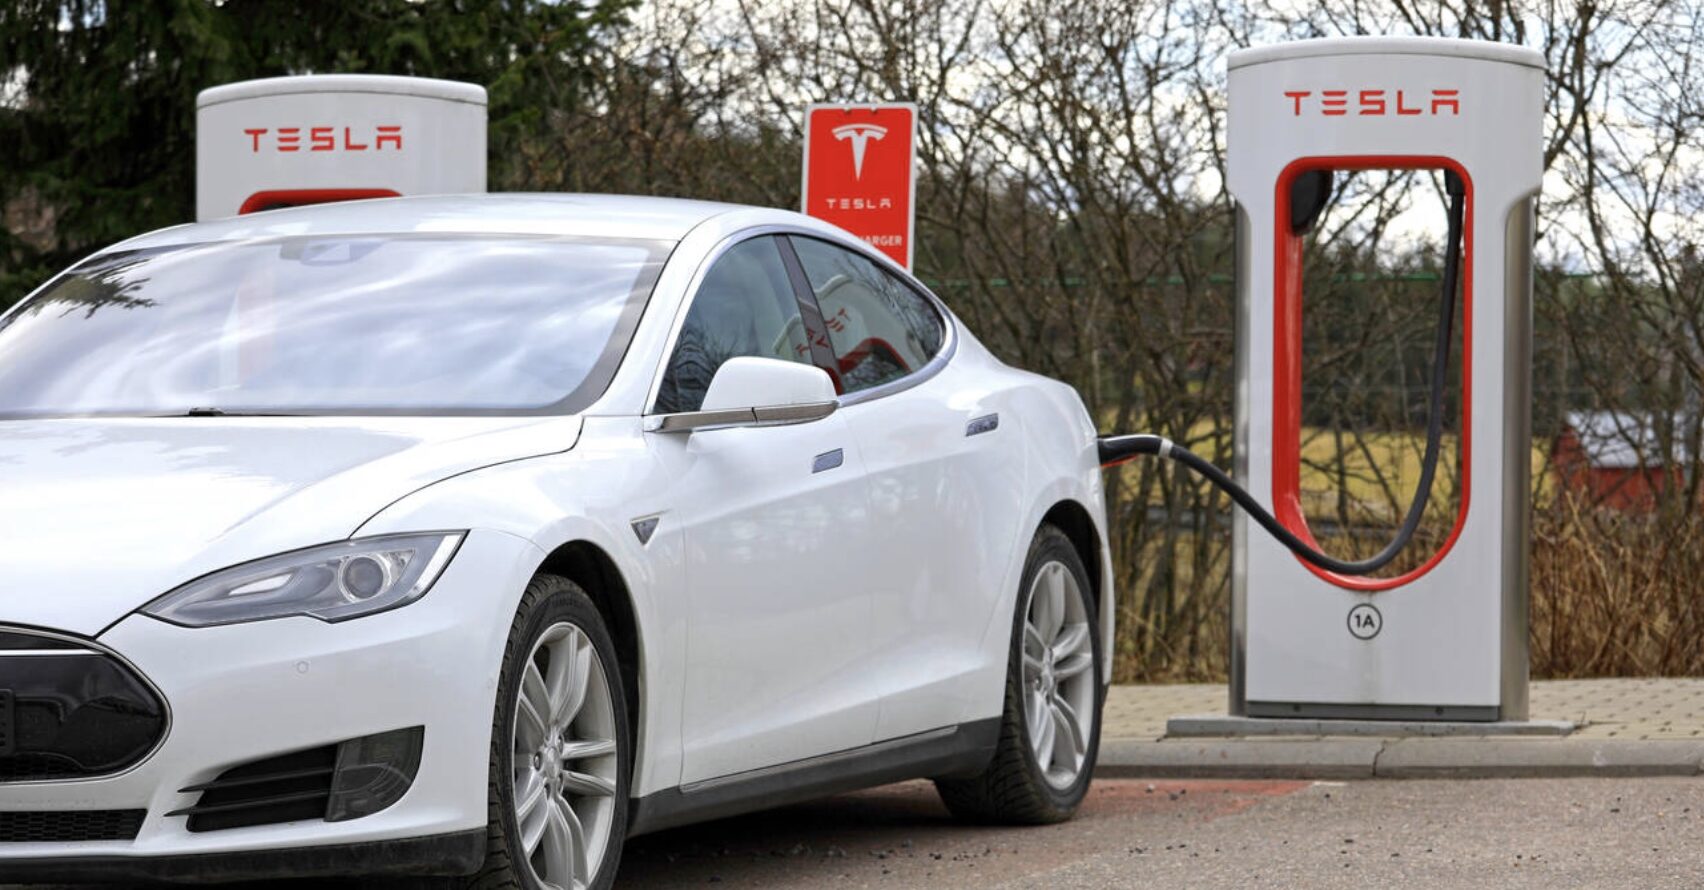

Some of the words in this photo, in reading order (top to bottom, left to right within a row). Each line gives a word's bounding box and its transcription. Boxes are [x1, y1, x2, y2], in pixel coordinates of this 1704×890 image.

[1284, 90, 1460, 116] TESLA
[244, 126, 402, 153] TESLA
[826, 198, 891, 210] TESLA
[1354, 614, 1375, 628] 1A
